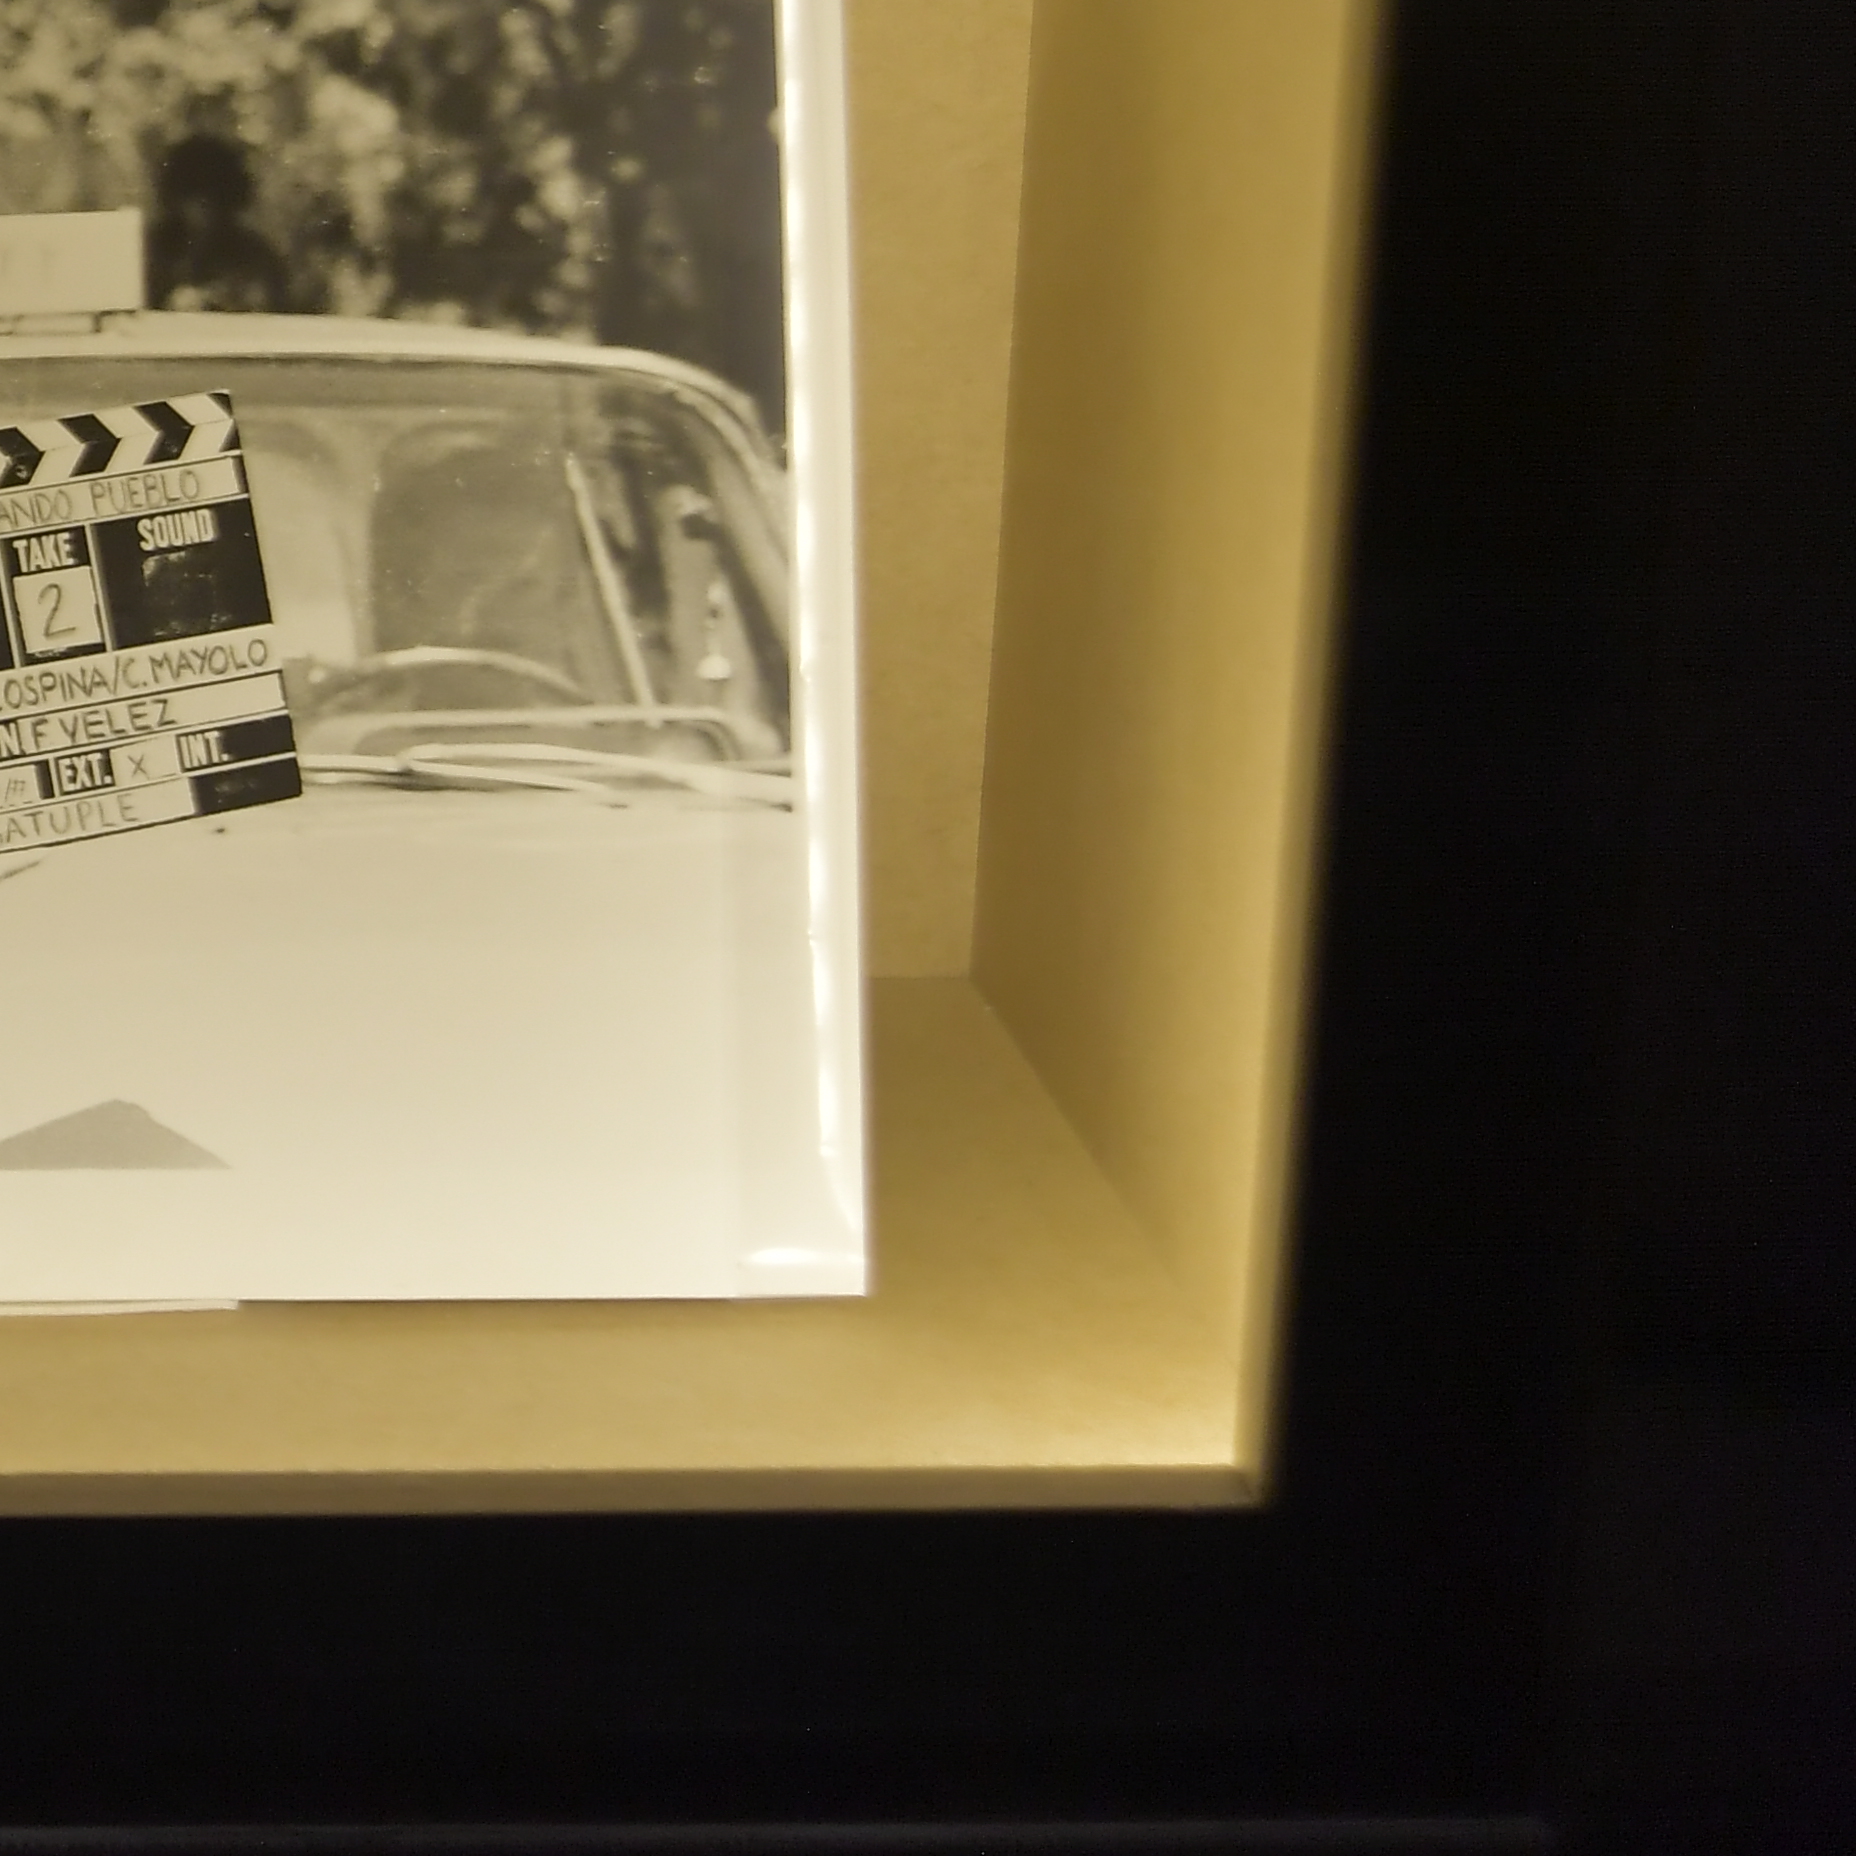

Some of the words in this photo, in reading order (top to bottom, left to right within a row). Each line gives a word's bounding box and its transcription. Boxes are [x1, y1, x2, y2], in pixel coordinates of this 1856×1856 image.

[88, 469, 202, 518] PUEBLO
[137, 508, 217, 552] SOUND
[12, 532, 76, 573] TAKE
[37, 582, 78, 639] 2
[57, 751, 114, 793] EXT.
[179, 730, 230, 771] INT.
